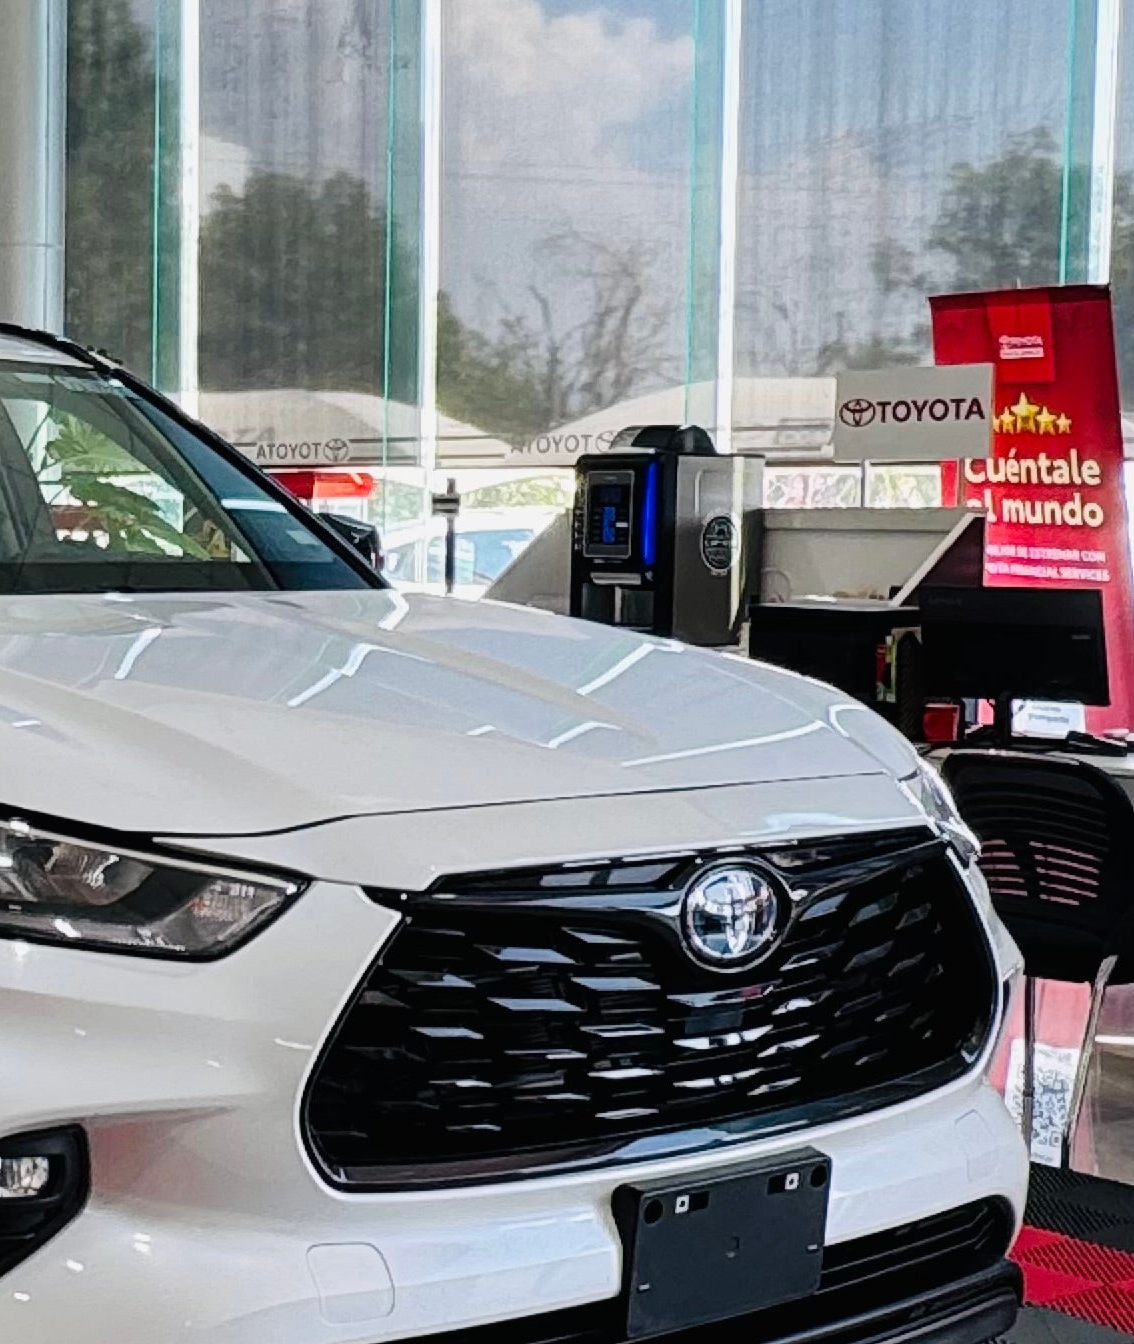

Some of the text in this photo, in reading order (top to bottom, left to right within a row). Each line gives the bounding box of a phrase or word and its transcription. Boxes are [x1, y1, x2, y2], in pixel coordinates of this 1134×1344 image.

[877, 397, 985, 423] TOYOTA
[964, 448, 1102, 485] Cuéntale
[1002, 492, 1104, 527] mundo
